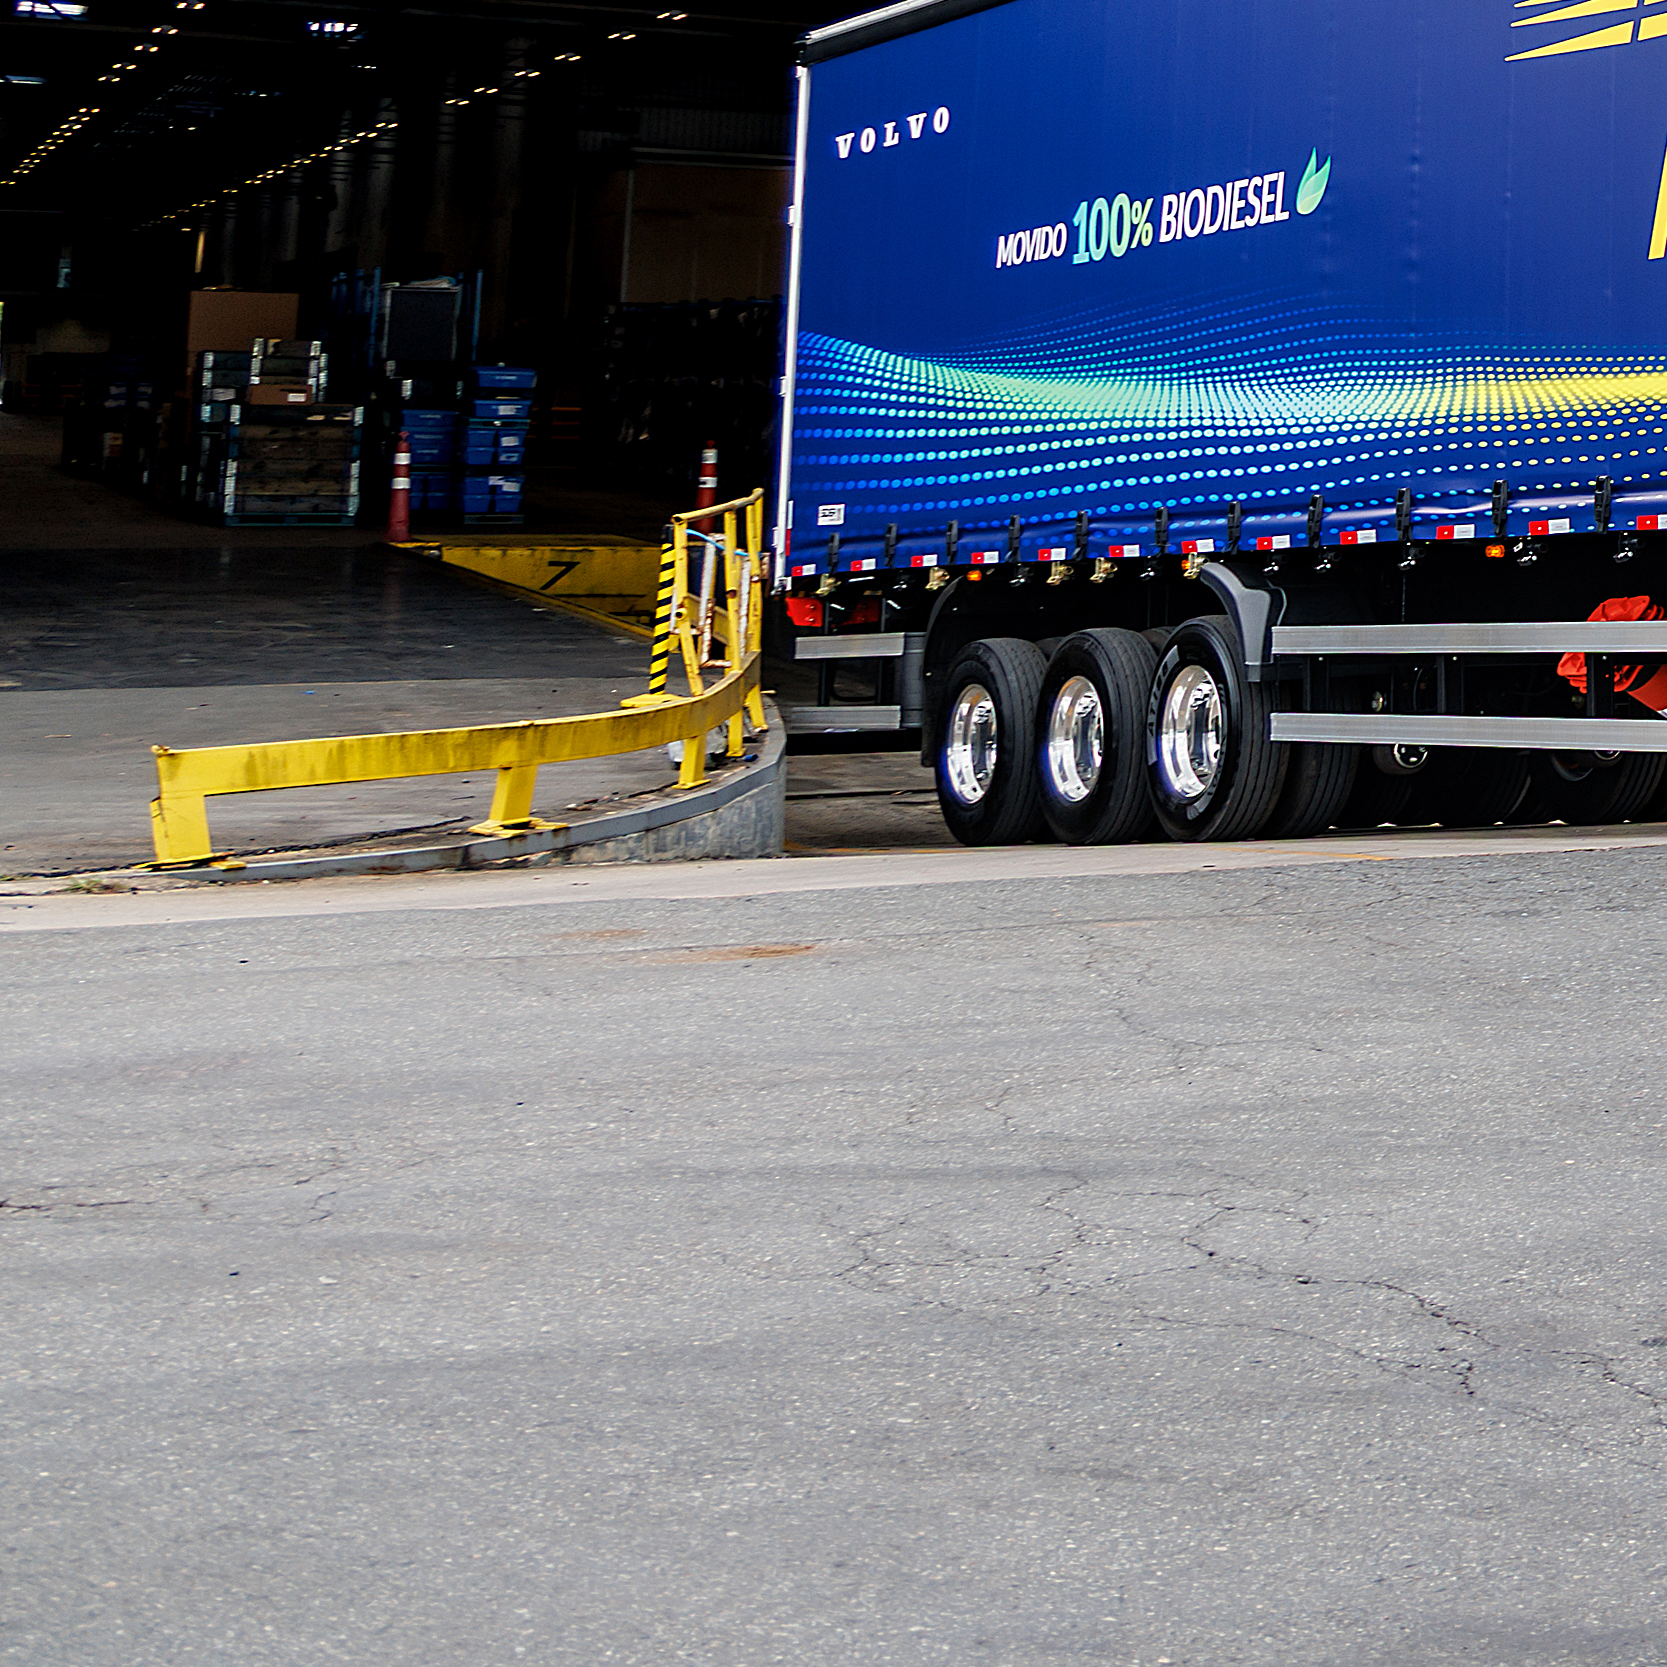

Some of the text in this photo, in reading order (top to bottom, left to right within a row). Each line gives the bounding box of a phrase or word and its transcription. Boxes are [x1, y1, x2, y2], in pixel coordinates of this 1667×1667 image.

[835, 106, 950, 159] VOLVO
[995, 171, 1289, 268] MOVIDO 100% BIODIESEL
[540, 560, 582, 590] 7
